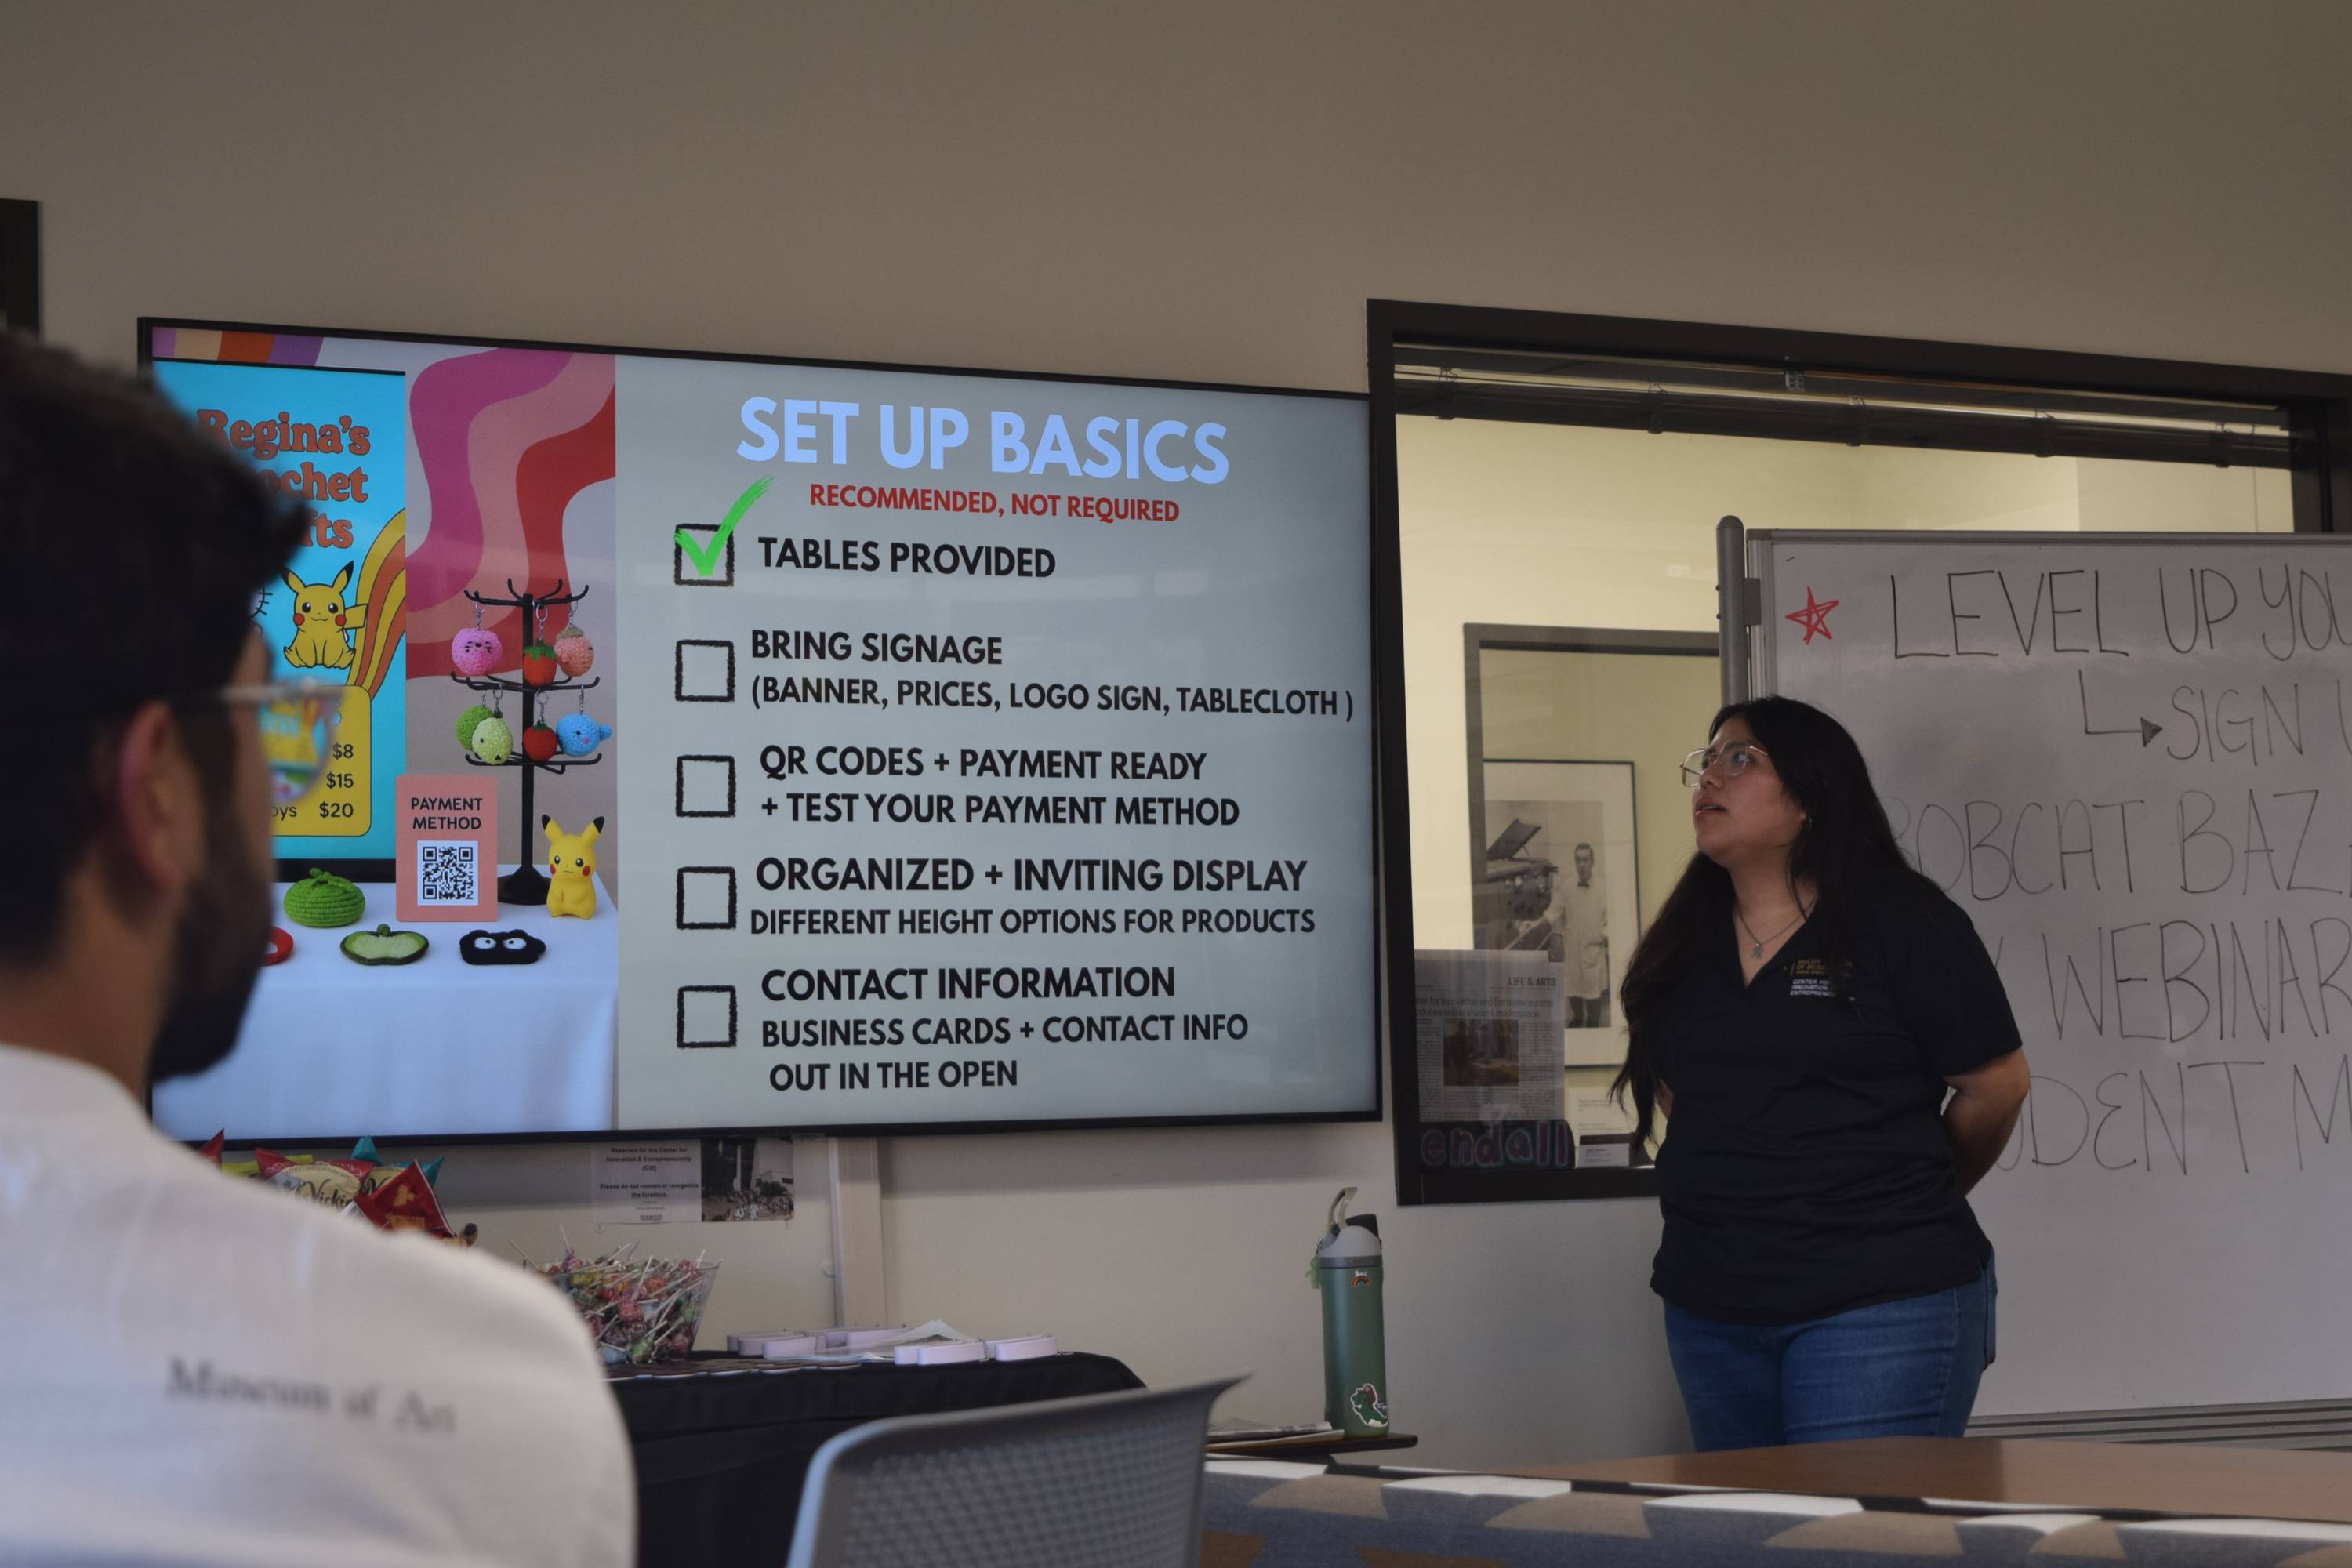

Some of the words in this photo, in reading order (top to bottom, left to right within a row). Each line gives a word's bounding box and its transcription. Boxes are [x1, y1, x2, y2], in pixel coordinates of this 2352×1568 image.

[197, 408, 371, 460] Regina's
[736, 397, 859, 464] SET
[880, 405, 969, 470] UP
[991, 411, 1229, 485] BASICS
[254, 461, 368, 503] ochet
[811, 483, 1004, 515] RECOMMENDED,
[1011, 493, 1059, 515] NOT
[1068, 495, 1179, 523] REQUIRED
[758, 537, 880, 571] TABLES
[891, 543, 1055, 577] PROVIDED
[1889, 569, 2130, 659] LEVEL
[2158, 565, 2238, 654] UP
[753, 630, 851, 660] BRING
[862, 633, 1001, 664] SIGNAGE
[753, 676, 887, 710] (BANNER,
[898, 681, 1000, 712] PRICES,
[1011, 683, 1089, 709] LOGO
[1097, 685, 1169, 716] SIGN,
[2166, 683, 2304, 767] SIGN
[332, 742, 354, 760] $8
[760, 745, 808, 780] QR
[816, 746, 924, 776] CODES
[935, 753, 949, 771] +
[961, 749, 1102, 778] PAYMENT
[1111, 752, 1207, 780] READY
[326, 771, 354, 789] $15
[319, 800, 354, 818] $20
[411, 797, 483, 811] PAYMENT
[762, 798, 778, 815] +
[786, 793, 858, 822] TEST
[865, 794, 956, 822] YOUR
[966, 795, 1106, 824] PAYMENT
[1116, 797, 1240, 826] METHOD
[412, 816, 482, 830] METHOD
[2178, 789, 2352, 895] BAZ
[757, 858, 974, 891] ORGANIZED
[985, 865, 1002, 884] +
[1015, 859, 1163, 891] INVITING
[1174, 859, 1308, 891] DISPLAY
[751, 910, 891, 934] DIFFERENT
[899, 909, 993, 934] HEIGHT
[1000, 909, 1116, 934] OPTIONS
[1124, 909, 1174, 933] FOR
[1183, 909, 1315, 933] PRODUCTS
[762, 968, 928, 1001] CONTACT
[939, 967, 1174, 999] INFORMATION
[1508, 977, 1526, 986] LIFE
[1527, 977, 1534, 986] &
[1535, 977, 1556, 986] ARTS
[763, 1018, 904, 1047] BUSINESS
[912, 1017, 1011, 1044] CARDS
[1020, 1022, 1034, 1038] +
[1043, 1015, 1175, 1043] CONTACT
[1184, 1014, 1248, 1040] INFO
[770, 1064, 830, 1091] OUT
[840, 1063, 869, 1089] IN
[877, 1062, 929, 1088] THE
[938, 1060, 1017, 1087] OPEN
